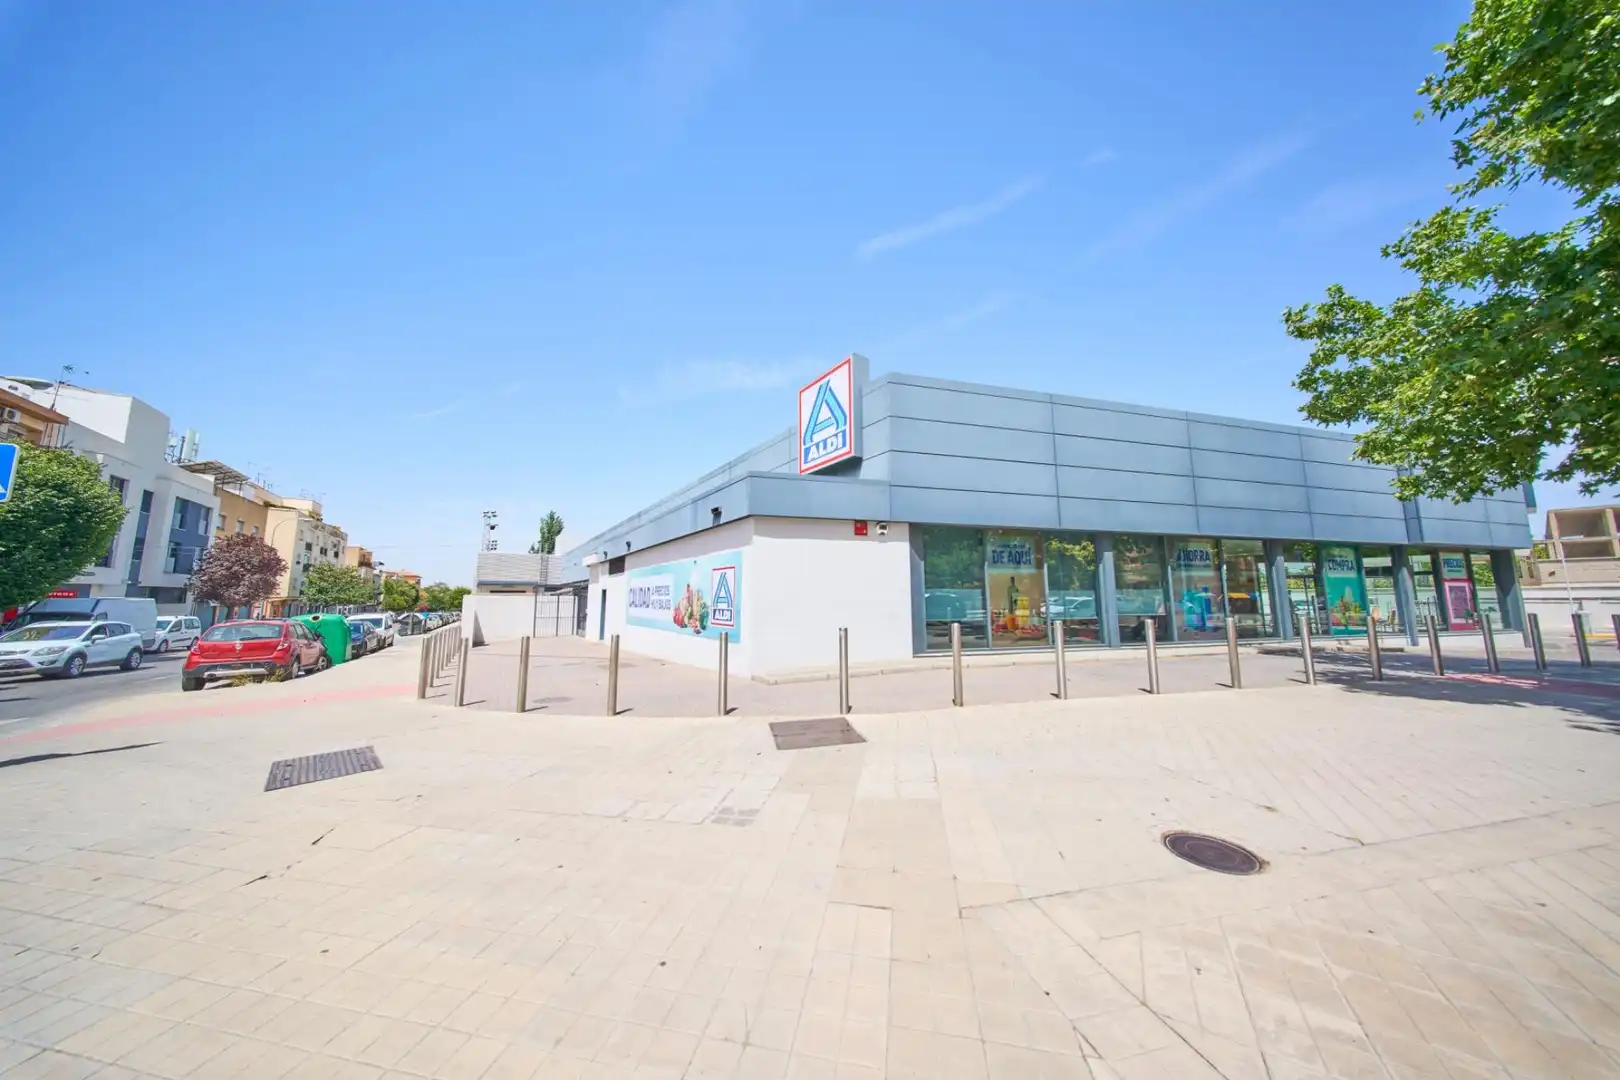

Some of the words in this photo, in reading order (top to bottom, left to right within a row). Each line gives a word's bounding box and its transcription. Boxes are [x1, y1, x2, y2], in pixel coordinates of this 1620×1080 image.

[807, 433, 843, 462] ALDI
[992, 549, 1005, 564] DE
[1328, 559, 1355, 571] COMPRA
[629, 587, 650, 608] CALIDAD
[715, 610, 731, 621] ALDI
